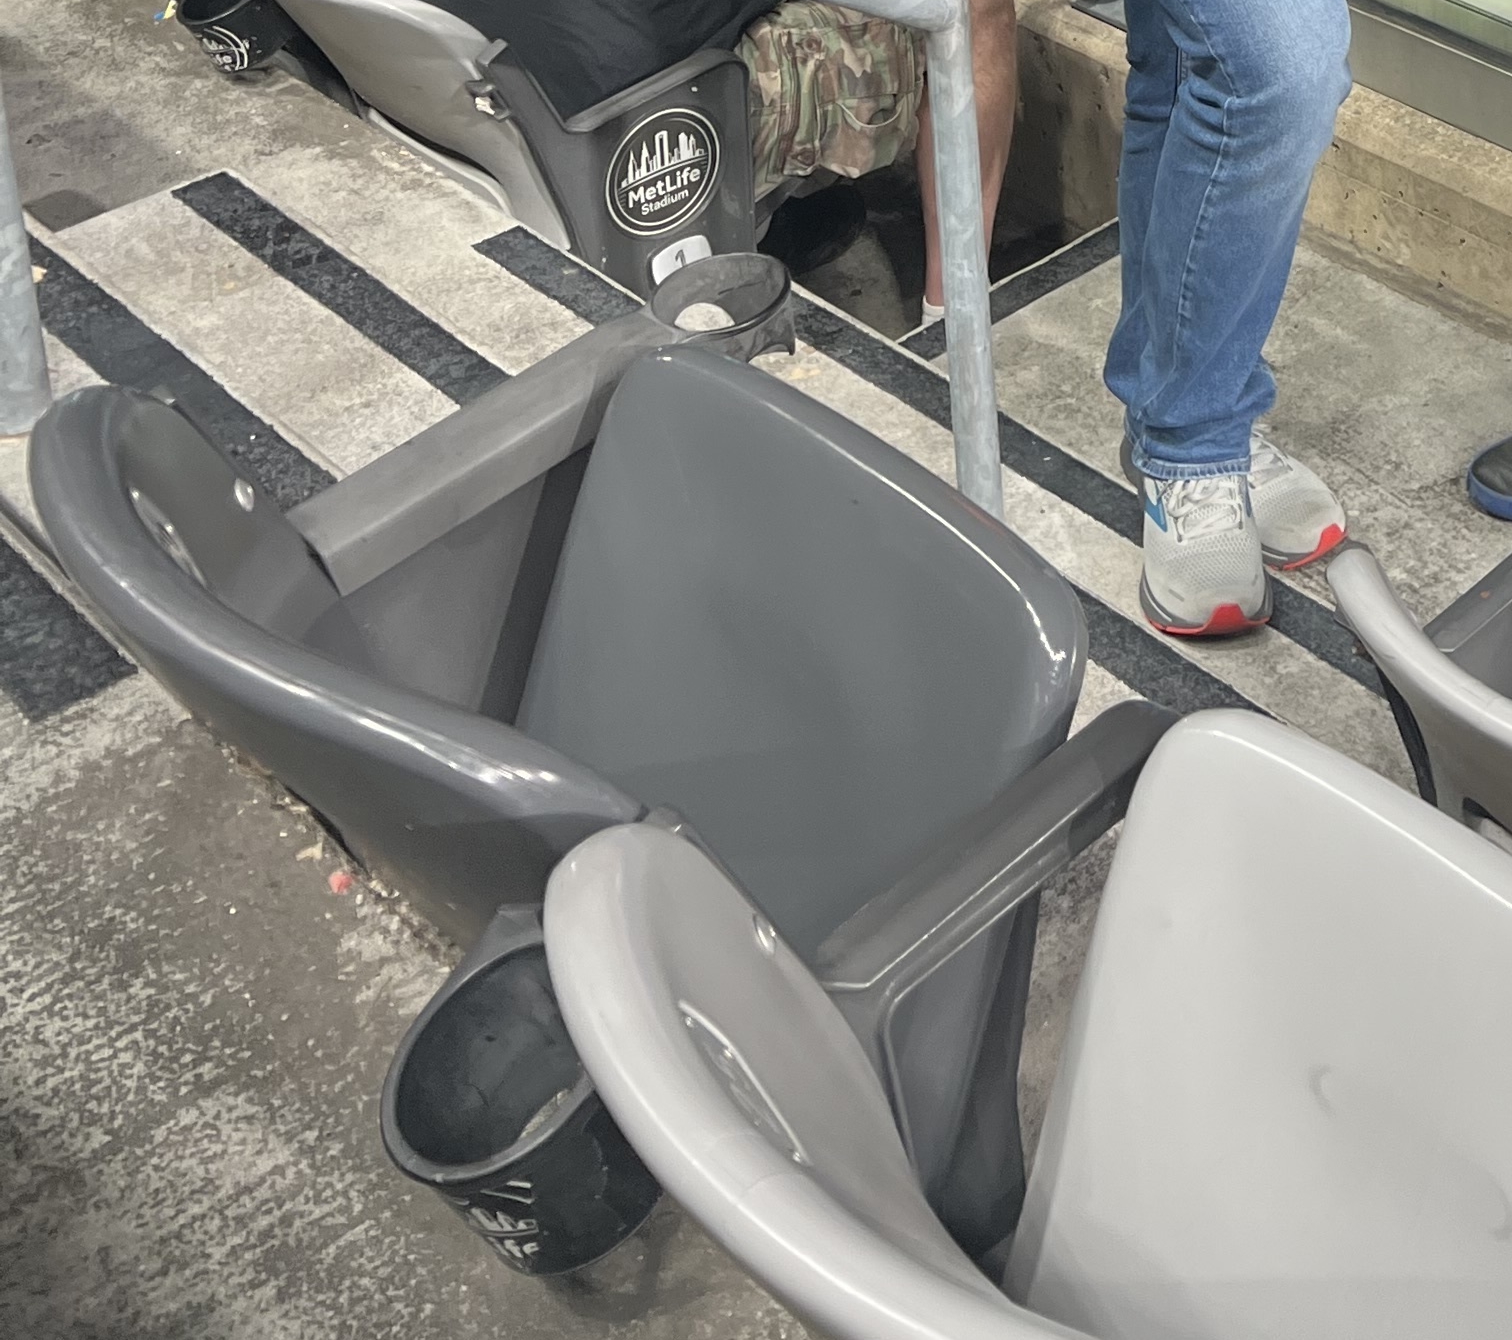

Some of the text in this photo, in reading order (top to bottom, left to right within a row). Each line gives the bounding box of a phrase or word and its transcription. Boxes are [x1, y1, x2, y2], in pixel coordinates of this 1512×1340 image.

[627, 166, 701, 209] MetLife
[640, 187, 690, 217] Stadium
[674, 248, 688, 268] 1
